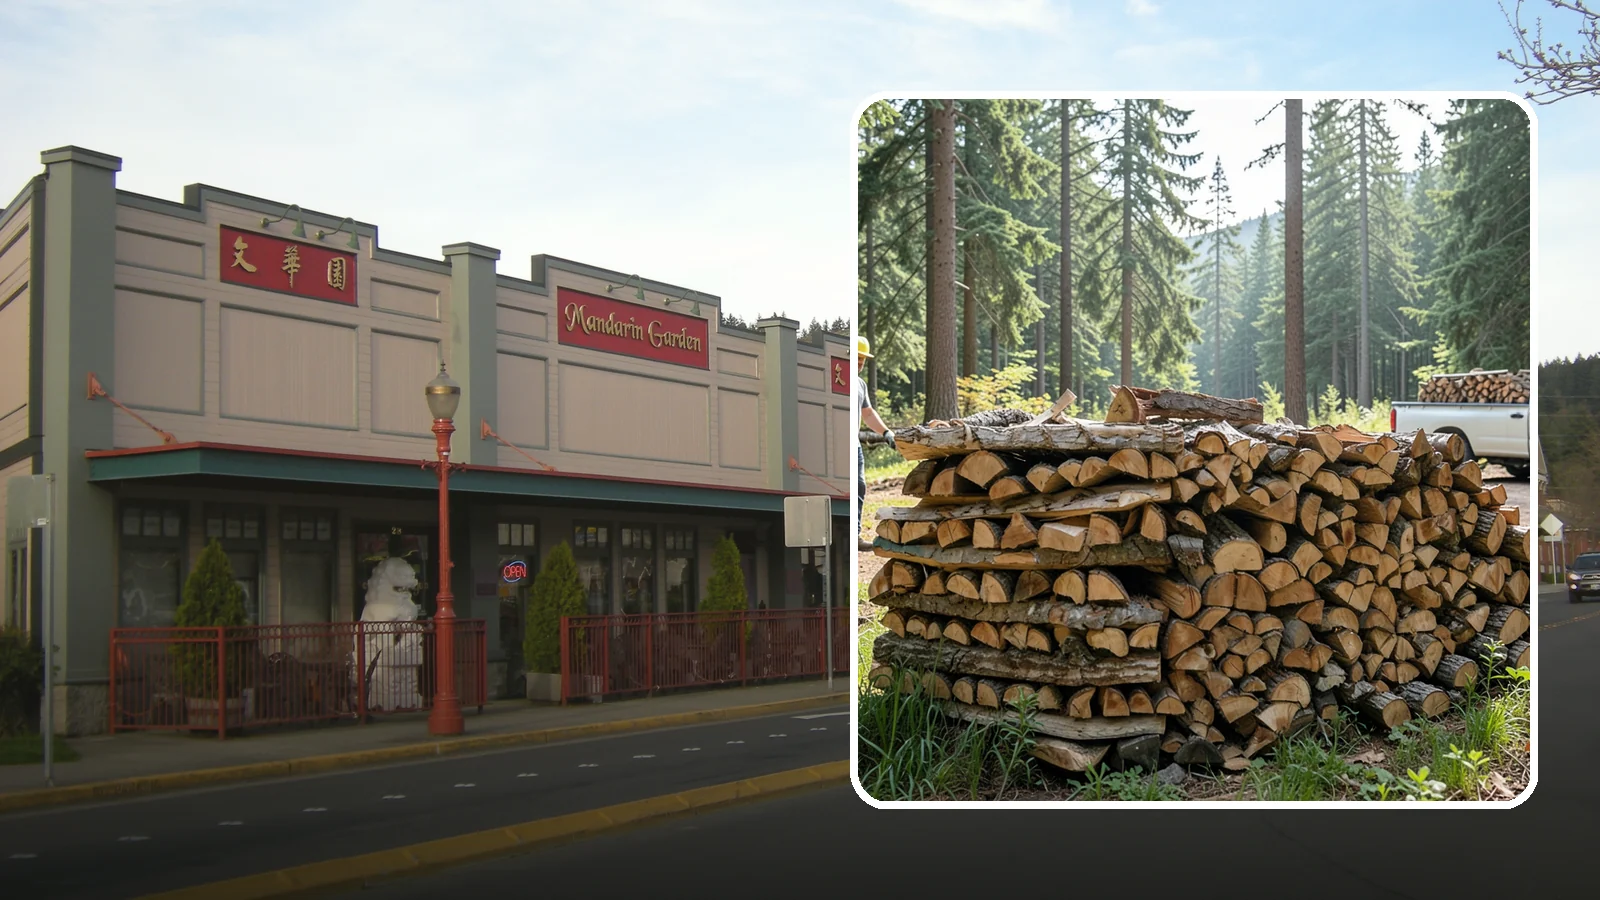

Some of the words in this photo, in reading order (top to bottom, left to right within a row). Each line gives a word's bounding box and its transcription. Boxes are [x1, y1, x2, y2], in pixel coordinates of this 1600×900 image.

[564, 302, 644, 341] Mandarin
[648, 320, 702, 352] Garden
[503, 565, 527, 578] OPEN
